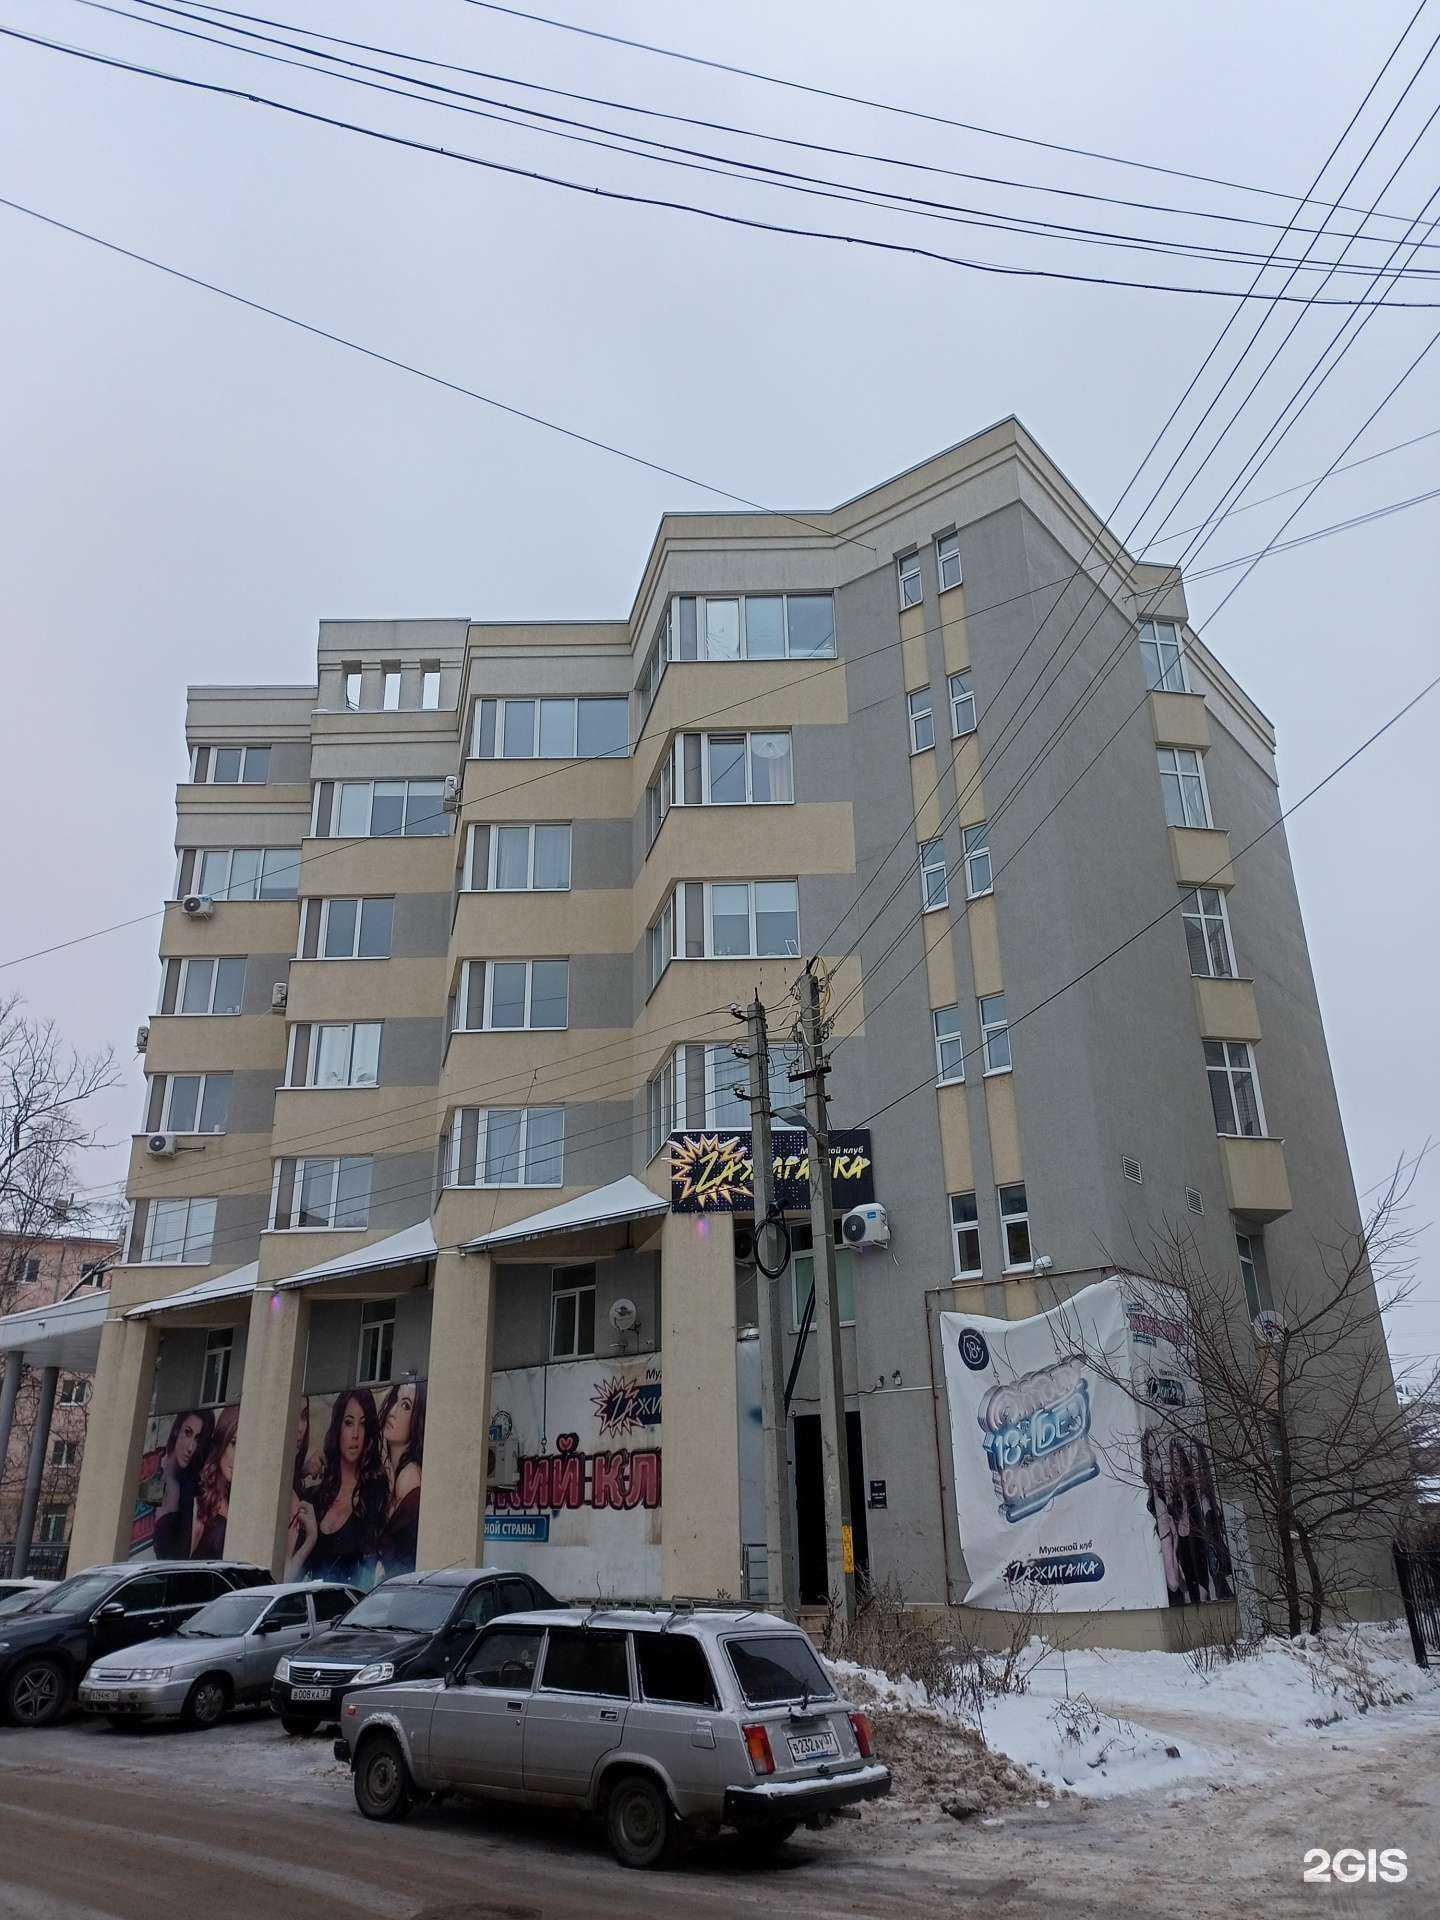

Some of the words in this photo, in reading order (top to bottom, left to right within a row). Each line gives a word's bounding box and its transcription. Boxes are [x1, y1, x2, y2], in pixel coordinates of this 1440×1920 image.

[843, 1145, 864, 1156] клуб
[502, 1522, 536, 1536] СТРАНЫ
[1038, 1542, 1078, 1556] Мужской
